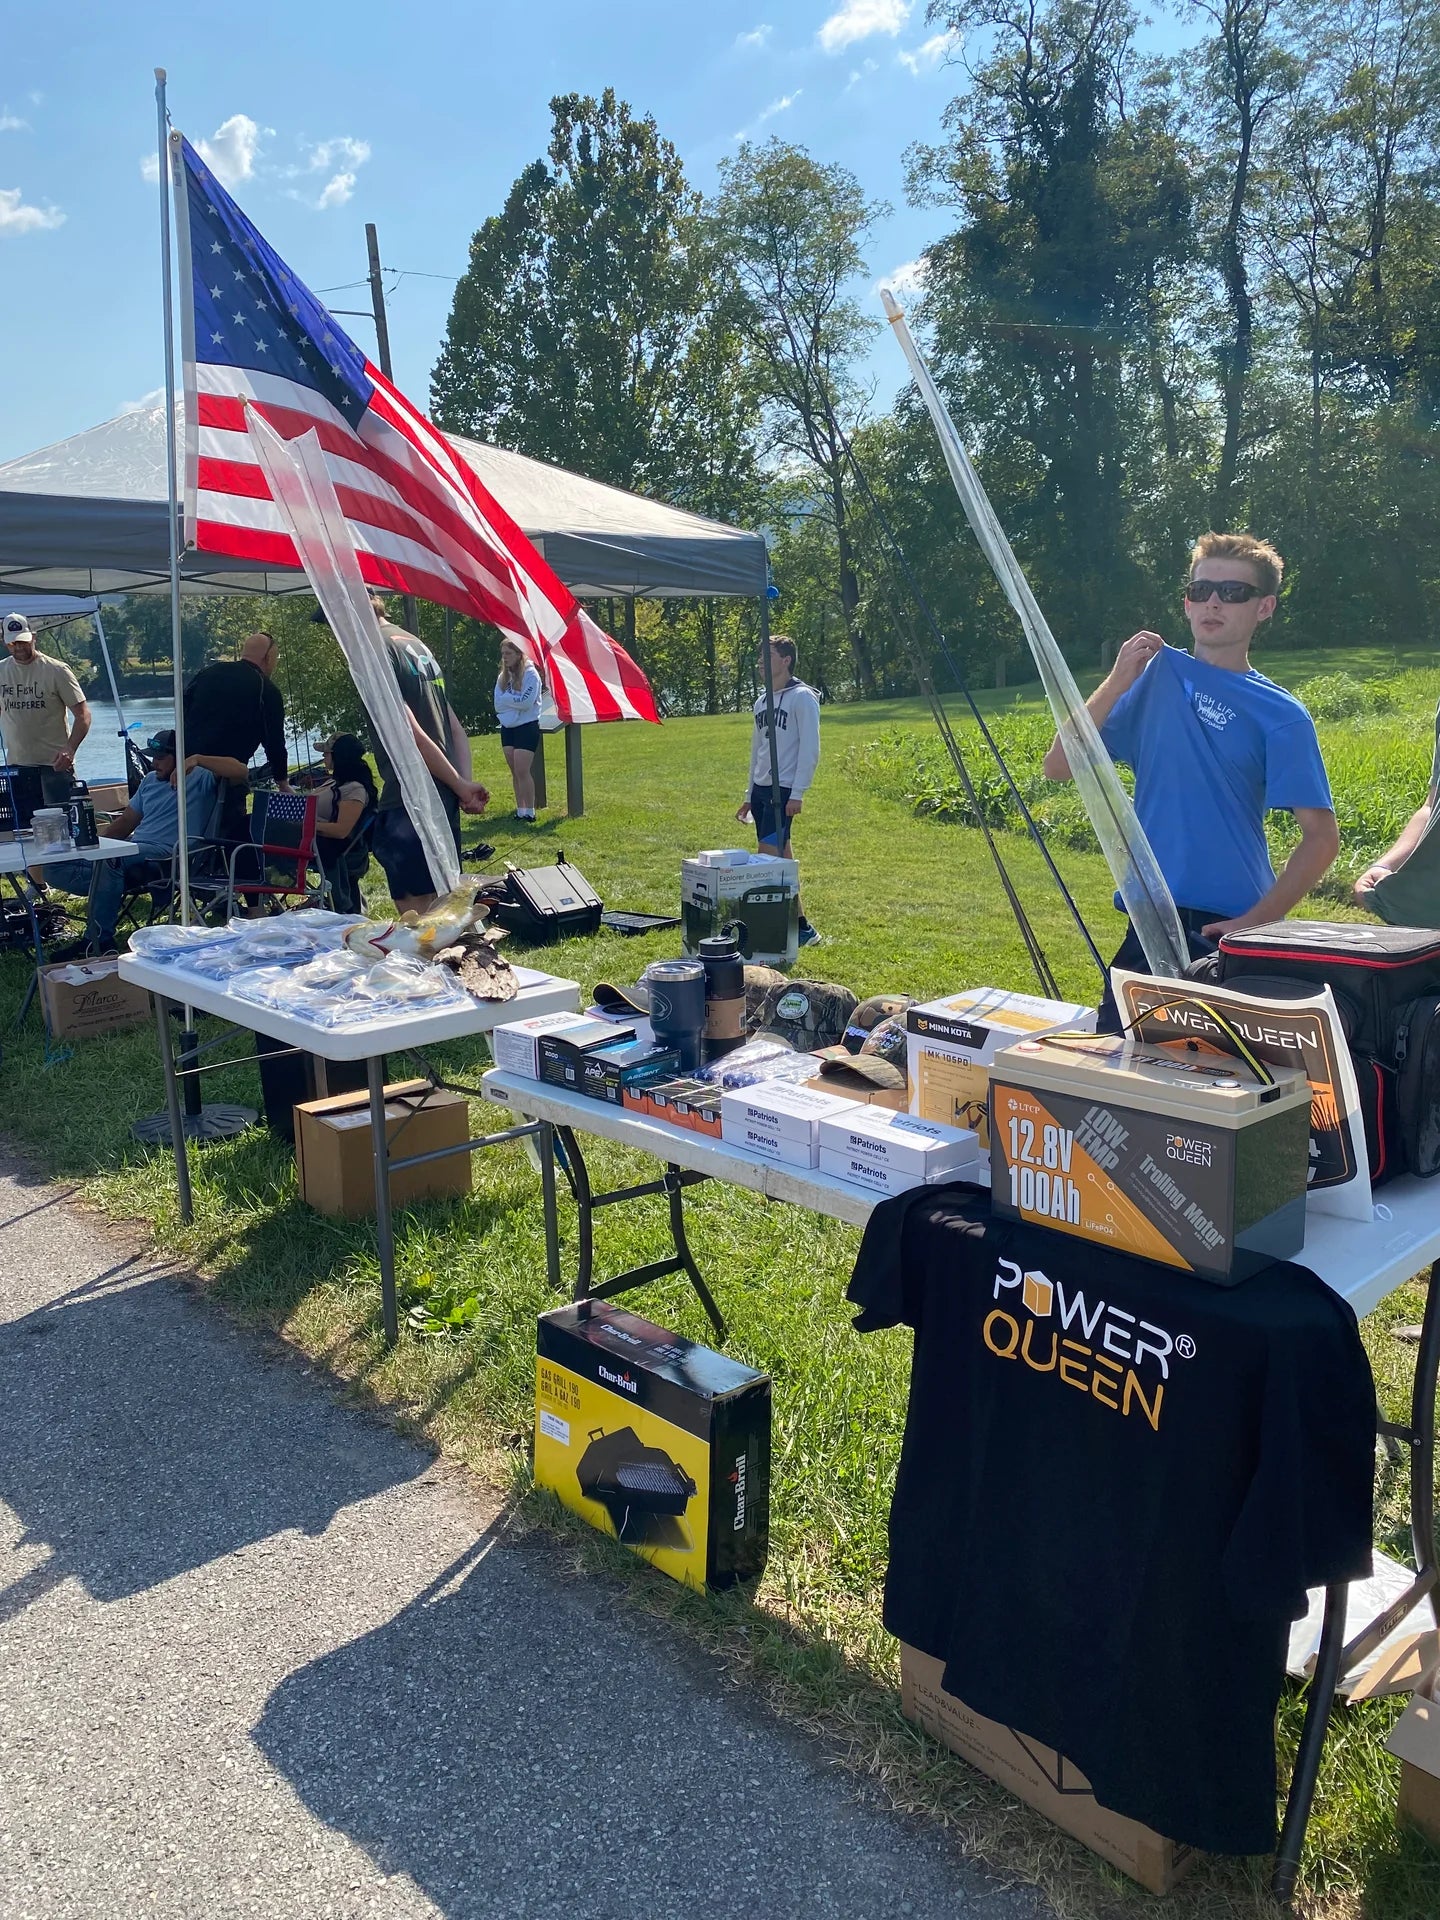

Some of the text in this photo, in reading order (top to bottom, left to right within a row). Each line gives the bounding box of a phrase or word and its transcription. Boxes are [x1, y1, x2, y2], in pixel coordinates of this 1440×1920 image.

[2, 684, 34, 698] THE FISH
[4, 699, 46, 712] WHISPERER
[1195, 692, 1237, 720] FISH LIFE
[719, 873, 744, 882] Explorer
[73, 991, 119, 1011] Marco
[1138, 1002, 1221, 1034] POWER
[928, 1022, 972, 1039] MINN KOTA
[927, 1049, 941, 1059] MK
[584, 1063, 606, 1079] APEX
[627, 1068, 660, 1081] ARDENT
[752, 1109, 779, 1125] Patriots
[1018, 1102, 1041, 1115] LTCP
[752, 1132, 779, 1148] Patriots
[856, 1137, 887, 1154] Patriots
[1008, 1116, 1074, 1174] 12.8V
[1166, 1133, 1213, 1154] POWER
[1166, 1146, 1212, 1168] QUEEN
[857, 1163, 888, 1181] Patriots
[1008, 1164, 1081, 1226] 100Ah
[1138, 1153, 1187, 1210] Trolling
[1183, 1201, 1226, 1248] Motor
[1085, 1220, 1115, 1236] LiFePO4
[598, 1364, 638, 1394] Char-Broil
[983, 1308, 1164, 1432] QUEEN
[540, 1367, 579, 1396] GAS GRILL 190
[540, 1379, 553, 1396] GRIL
[570, 1396, 581, 1411] 190
[733, 1453, 747, 1532] Char-Broil
